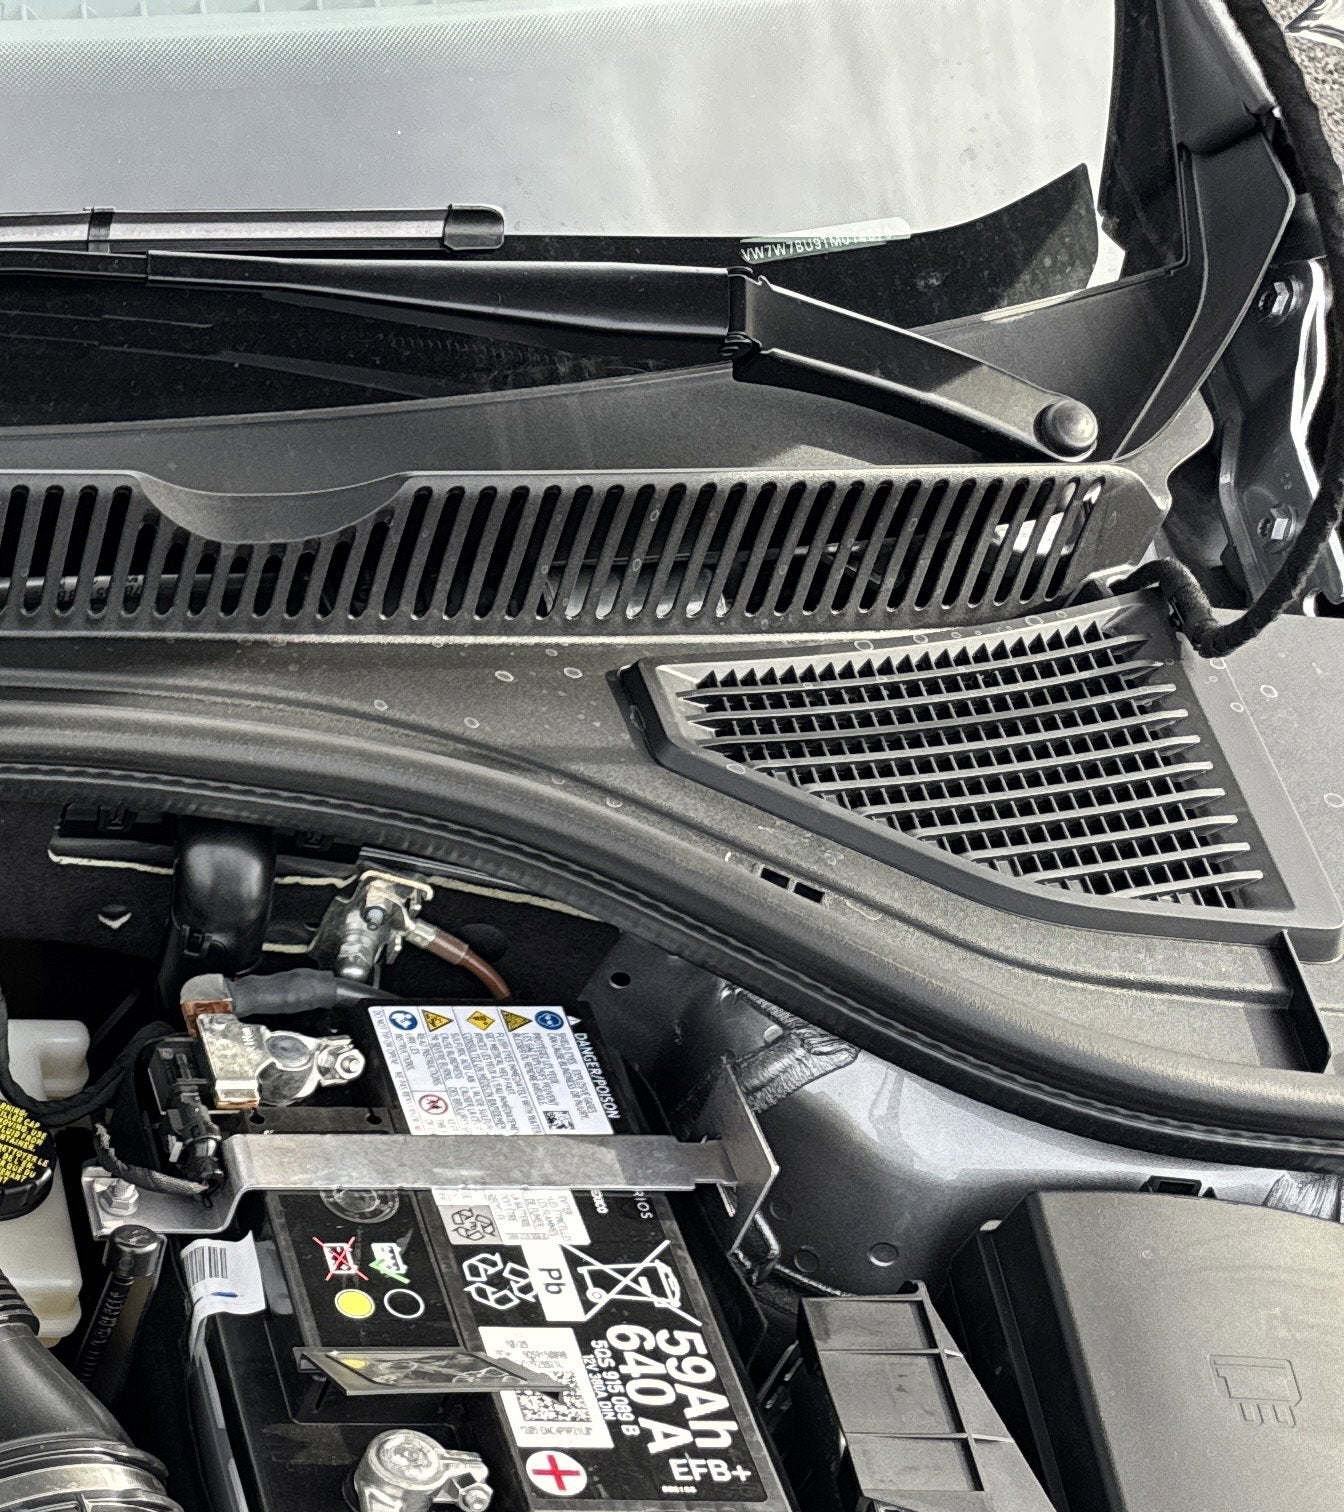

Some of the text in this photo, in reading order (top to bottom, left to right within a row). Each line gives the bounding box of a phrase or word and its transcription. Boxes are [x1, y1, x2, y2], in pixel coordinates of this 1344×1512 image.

[572, 1032, 620, 1118] DANGER/POISON
[539, 1267, 564, 1296] Pb
[605, 1323, 677, 1407] 640
[607, 1369, 626, 1394] 915
[655, 1329, 739, 1450] 59Ah
[613, 1393, 636, 1423] 089
[638, 1417, 694, 1455] A
[668, 1458, 752, 1482] EFB+
